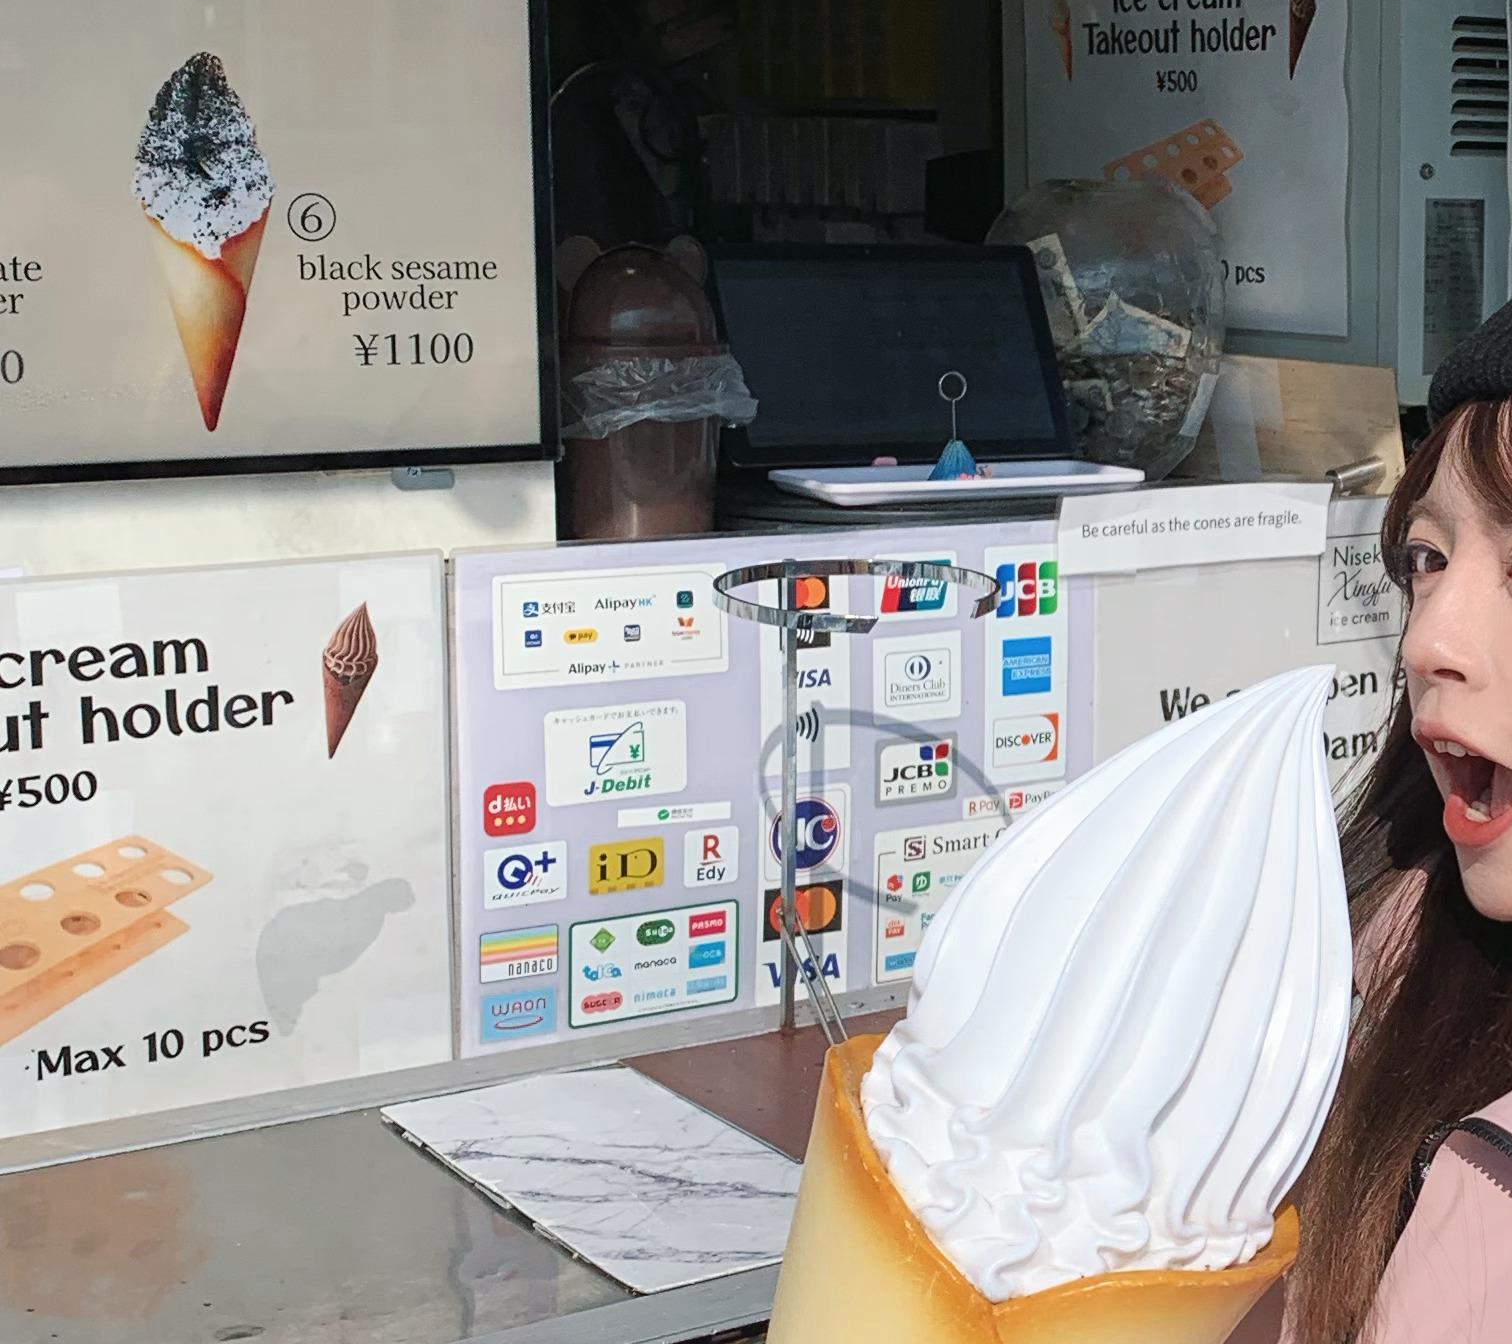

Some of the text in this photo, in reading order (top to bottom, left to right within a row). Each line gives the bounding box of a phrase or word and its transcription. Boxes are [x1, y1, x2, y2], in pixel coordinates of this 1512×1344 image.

[1082, 17, 1277, 56] Takeout holder
[1156, 70, 1198, 93] ¥500
[298, 253, 499, 282] black sesame
[1235, 265, 1266, 285] pcs
[342, 285, 459, 317] powder
[353, 332, 475, 367] ¥1100
[1081, 510, 1303, 539] Be careful as the cones are fragile.
[1333, 543, 1382, 568] Nisek
[999, 580, 1056, 602] JCB
[1330, 609, 1390, 627] ice cream
[0, 638, 209, 689] cream
[890, 680, 946, 694] Diners Club
[1326, 670, 1378, 706] pen
[81, 685, 295, 744] holder
[995, 731, 1053, 749] DISCOVER
[584, 773, 651, 796] J-Debit
[883, 763, 934, 783] JCB
[885, 779, 948, 797] PREMO
[488, 794, 532, 815] d払い
[932, 832, 987, 856] Smart
[696, 865, 727, 882] Edy
[691, 918, 724, 931] PASMO
[508, 958, 554, 977] nanaco
[634, 956, 677, 971] manaca
[763, 953, 841, 989] VSA
[37, 1020, 270, 1081] Max 10 pcs
